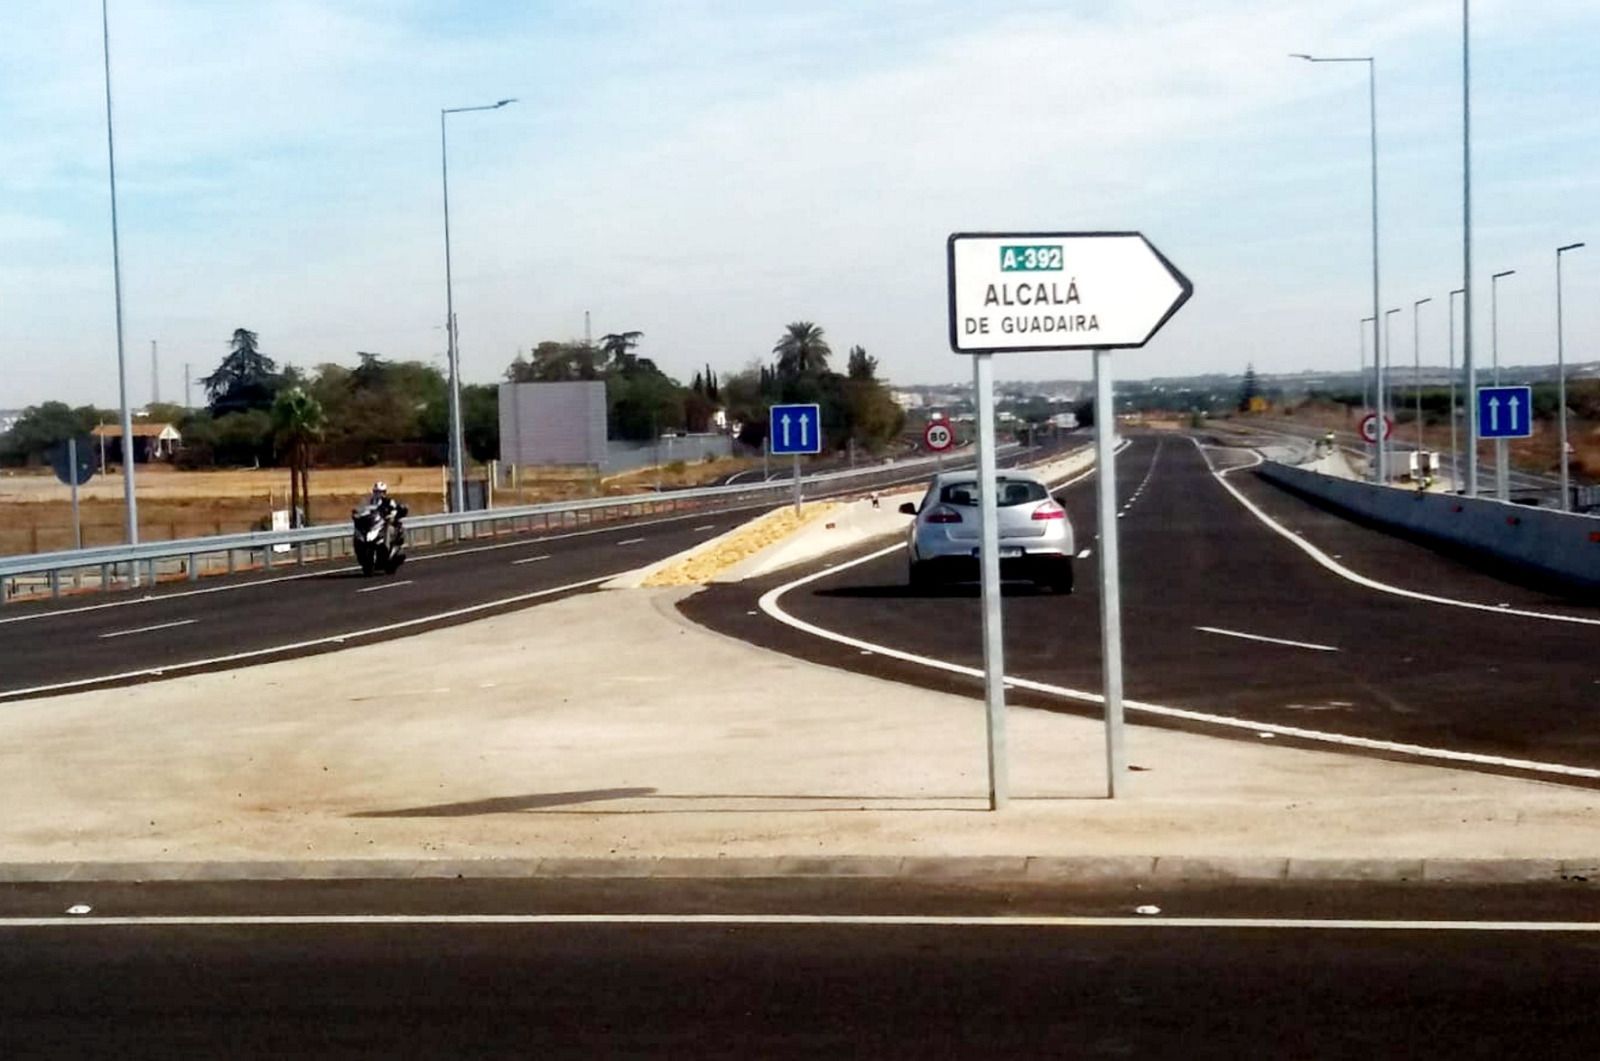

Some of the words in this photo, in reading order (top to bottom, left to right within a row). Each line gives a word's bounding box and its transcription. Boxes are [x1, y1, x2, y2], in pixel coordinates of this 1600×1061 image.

[1003, 248, 1061, 269] A-392
[984, 277, 1080, 306] ALCALÁ
[965, 317, 990, 335] DE
[1001, 314, 1100, 334] GUADAIRA
[930, 432, 947, 442] 80
